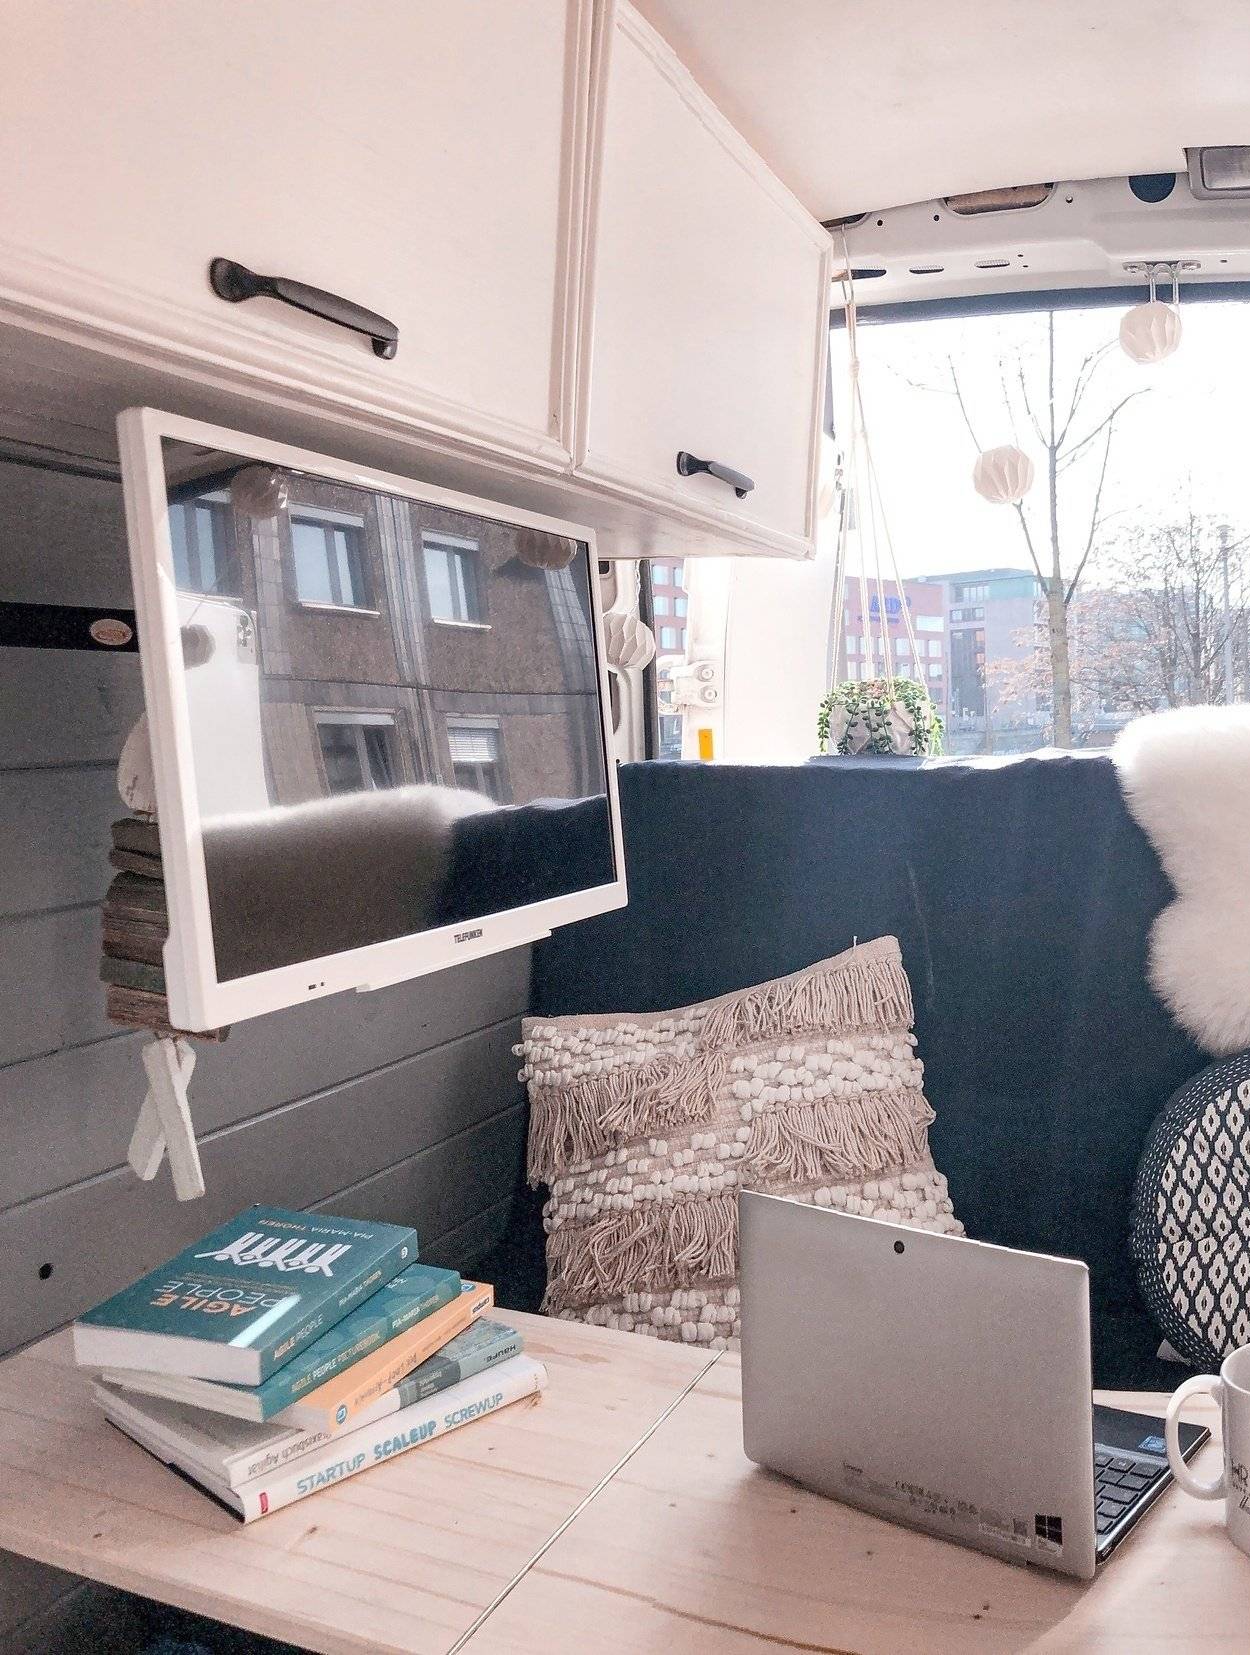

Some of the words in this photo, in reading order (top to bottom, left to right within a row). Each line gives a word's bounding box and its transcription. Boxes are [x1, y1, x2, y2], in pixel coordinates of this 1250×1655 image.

[453, 928, 484, 944] TELEFUNKEN
[150, 1292, 258, 1317] AGILE
[297, 1453, 366, 1495] STARTUP
[373, 1420, 437, 1460] SCALEUP
[444, 1393, 503, 1429] SCREWUP
